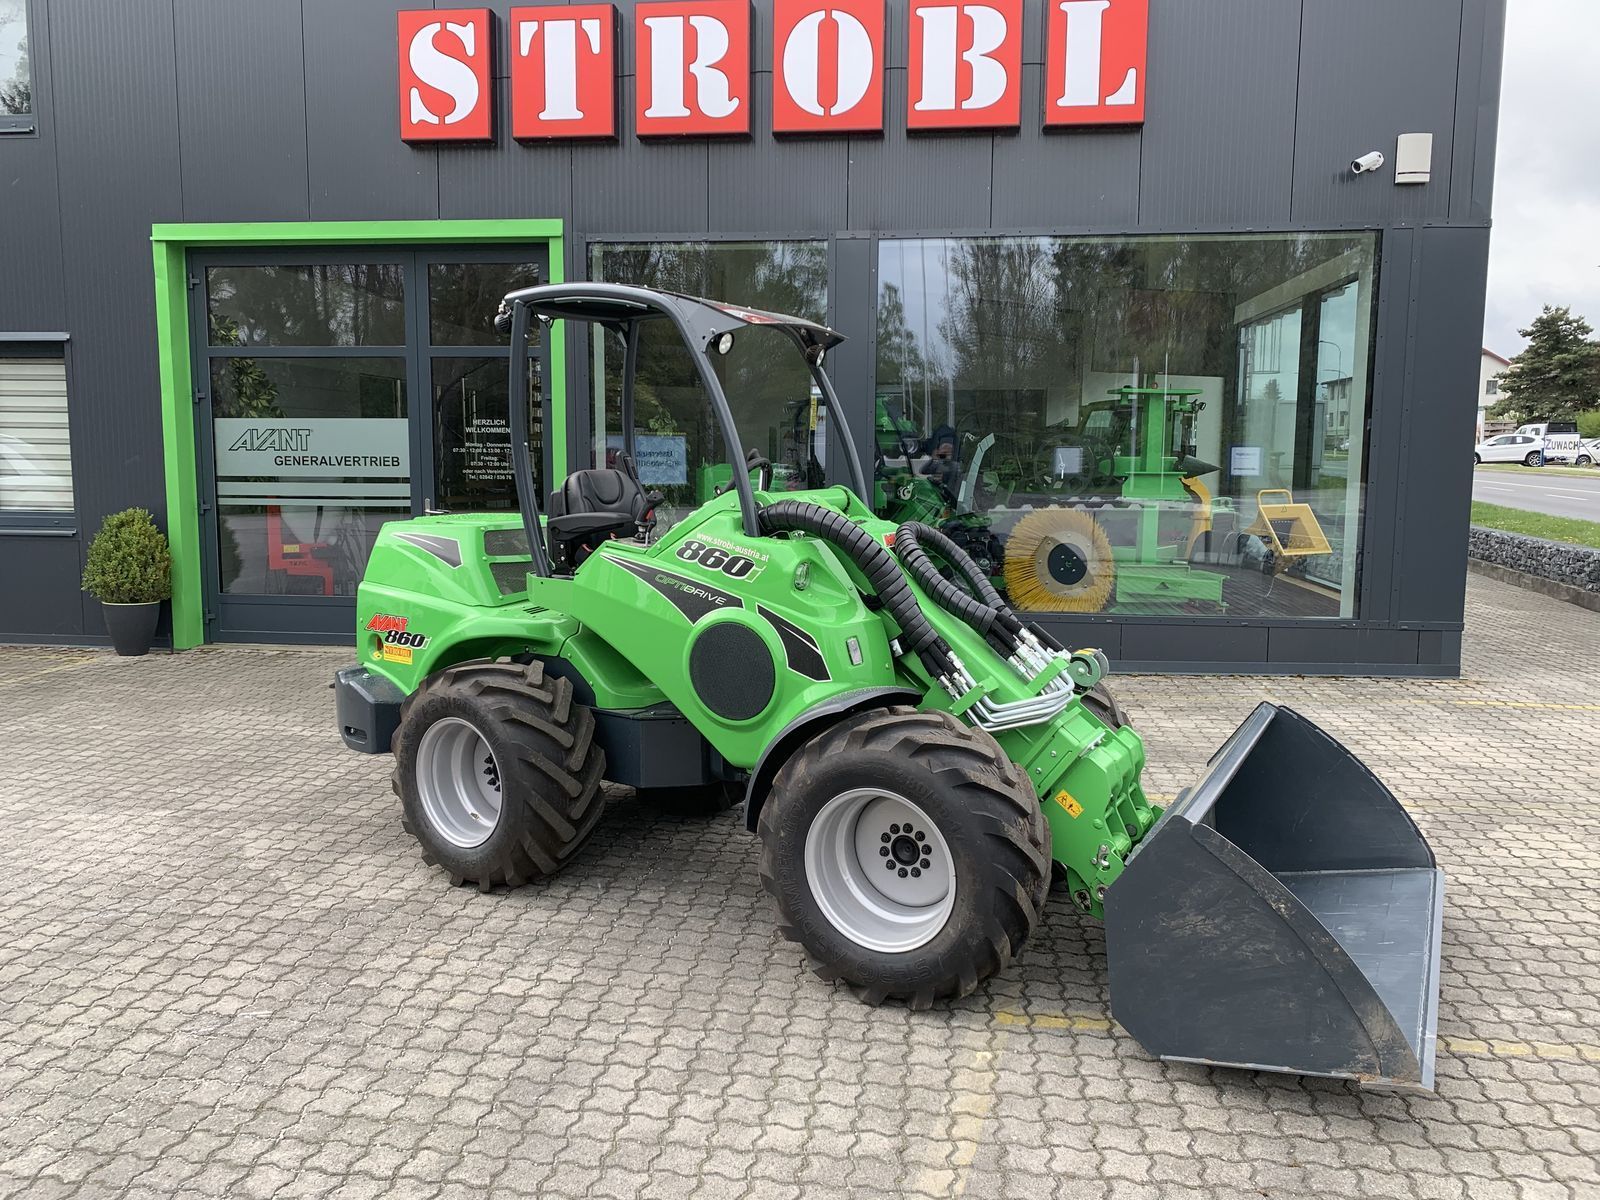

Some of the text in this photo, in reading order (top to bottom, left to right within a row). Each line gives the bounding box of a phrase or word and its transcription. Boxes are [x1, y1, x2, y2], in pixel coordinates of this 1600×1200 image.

[408, 1, 1138, 126] STROBL
[228, 428, 312, 451] AVANT
[274, 455, 400, 468] GENERALVERTRIEB
[696, 532, 769, 562] www.strobl-austria.at
[655, 573, 727, 606] OPTIDRIVE
